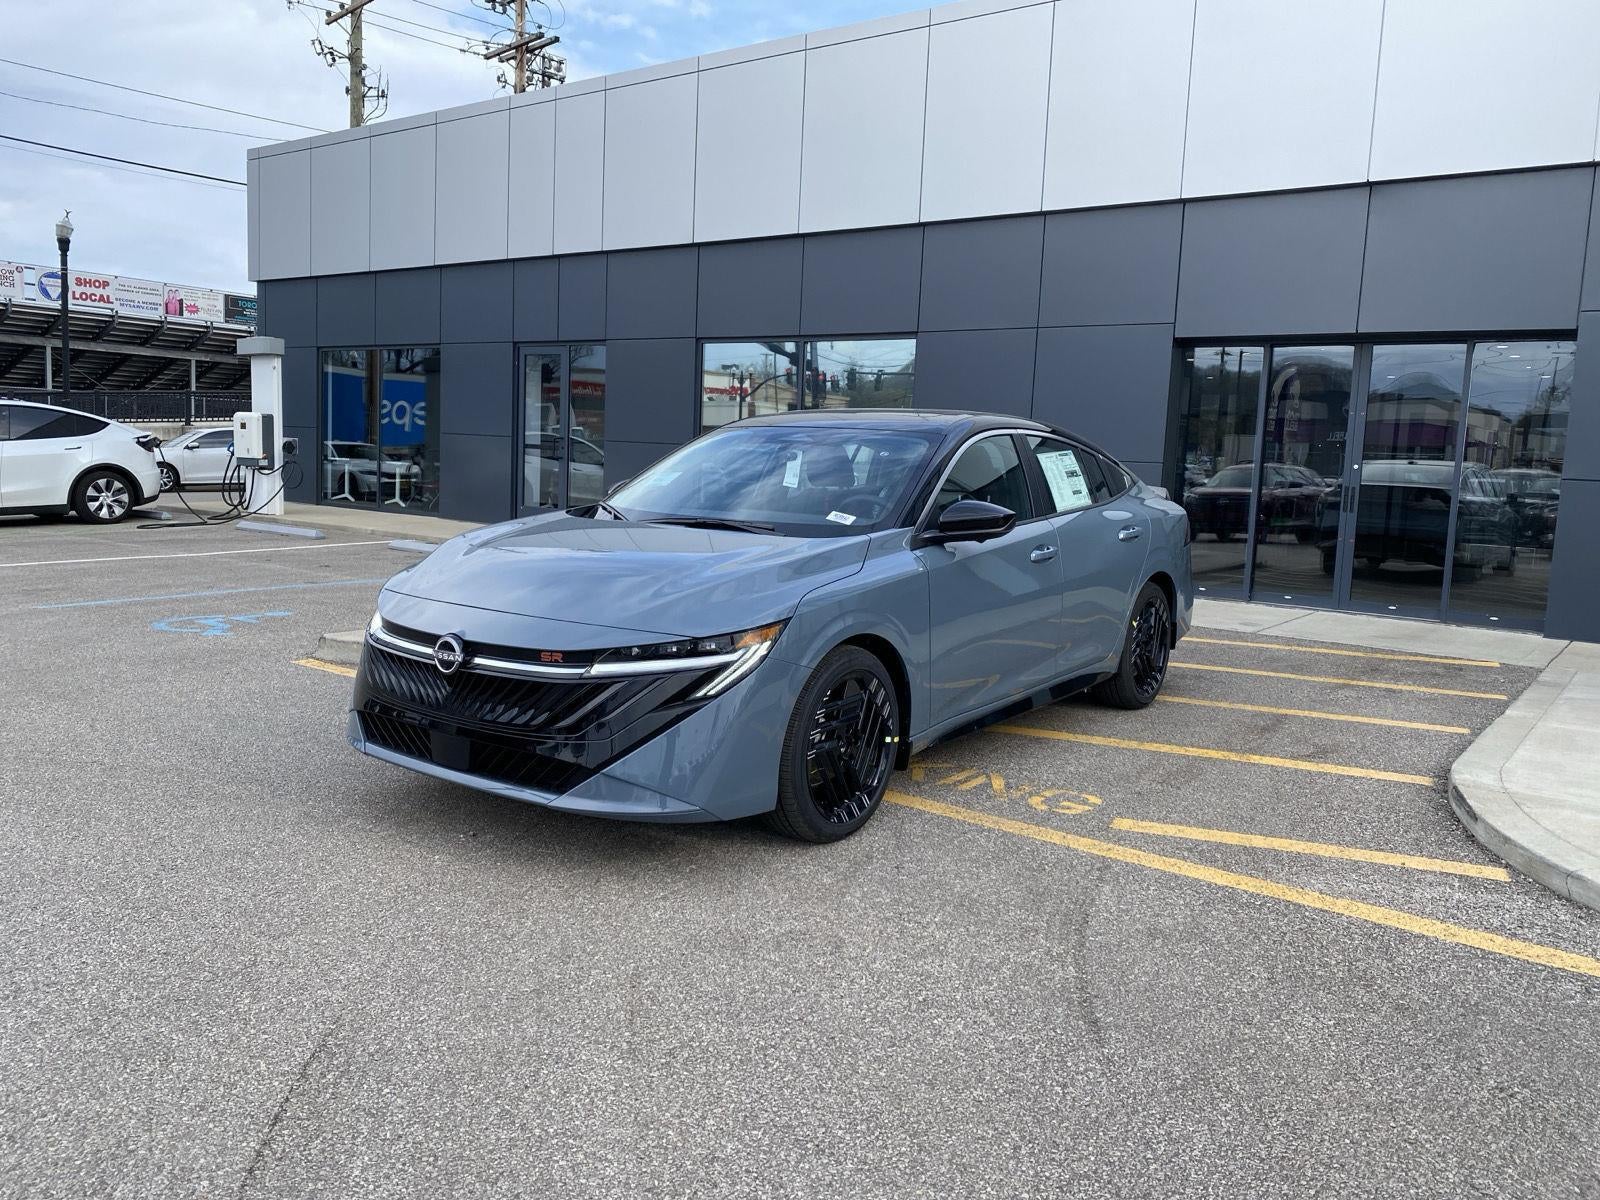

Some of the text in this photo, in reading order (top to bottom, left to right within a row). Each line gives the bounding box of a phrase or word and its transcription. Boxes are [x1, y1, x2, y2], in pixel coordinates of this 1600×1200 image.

[75, 276, 110, 289] SHOP
[72, 291, 114, 304] LOCAL
[541, 651, 563, 662] SR
